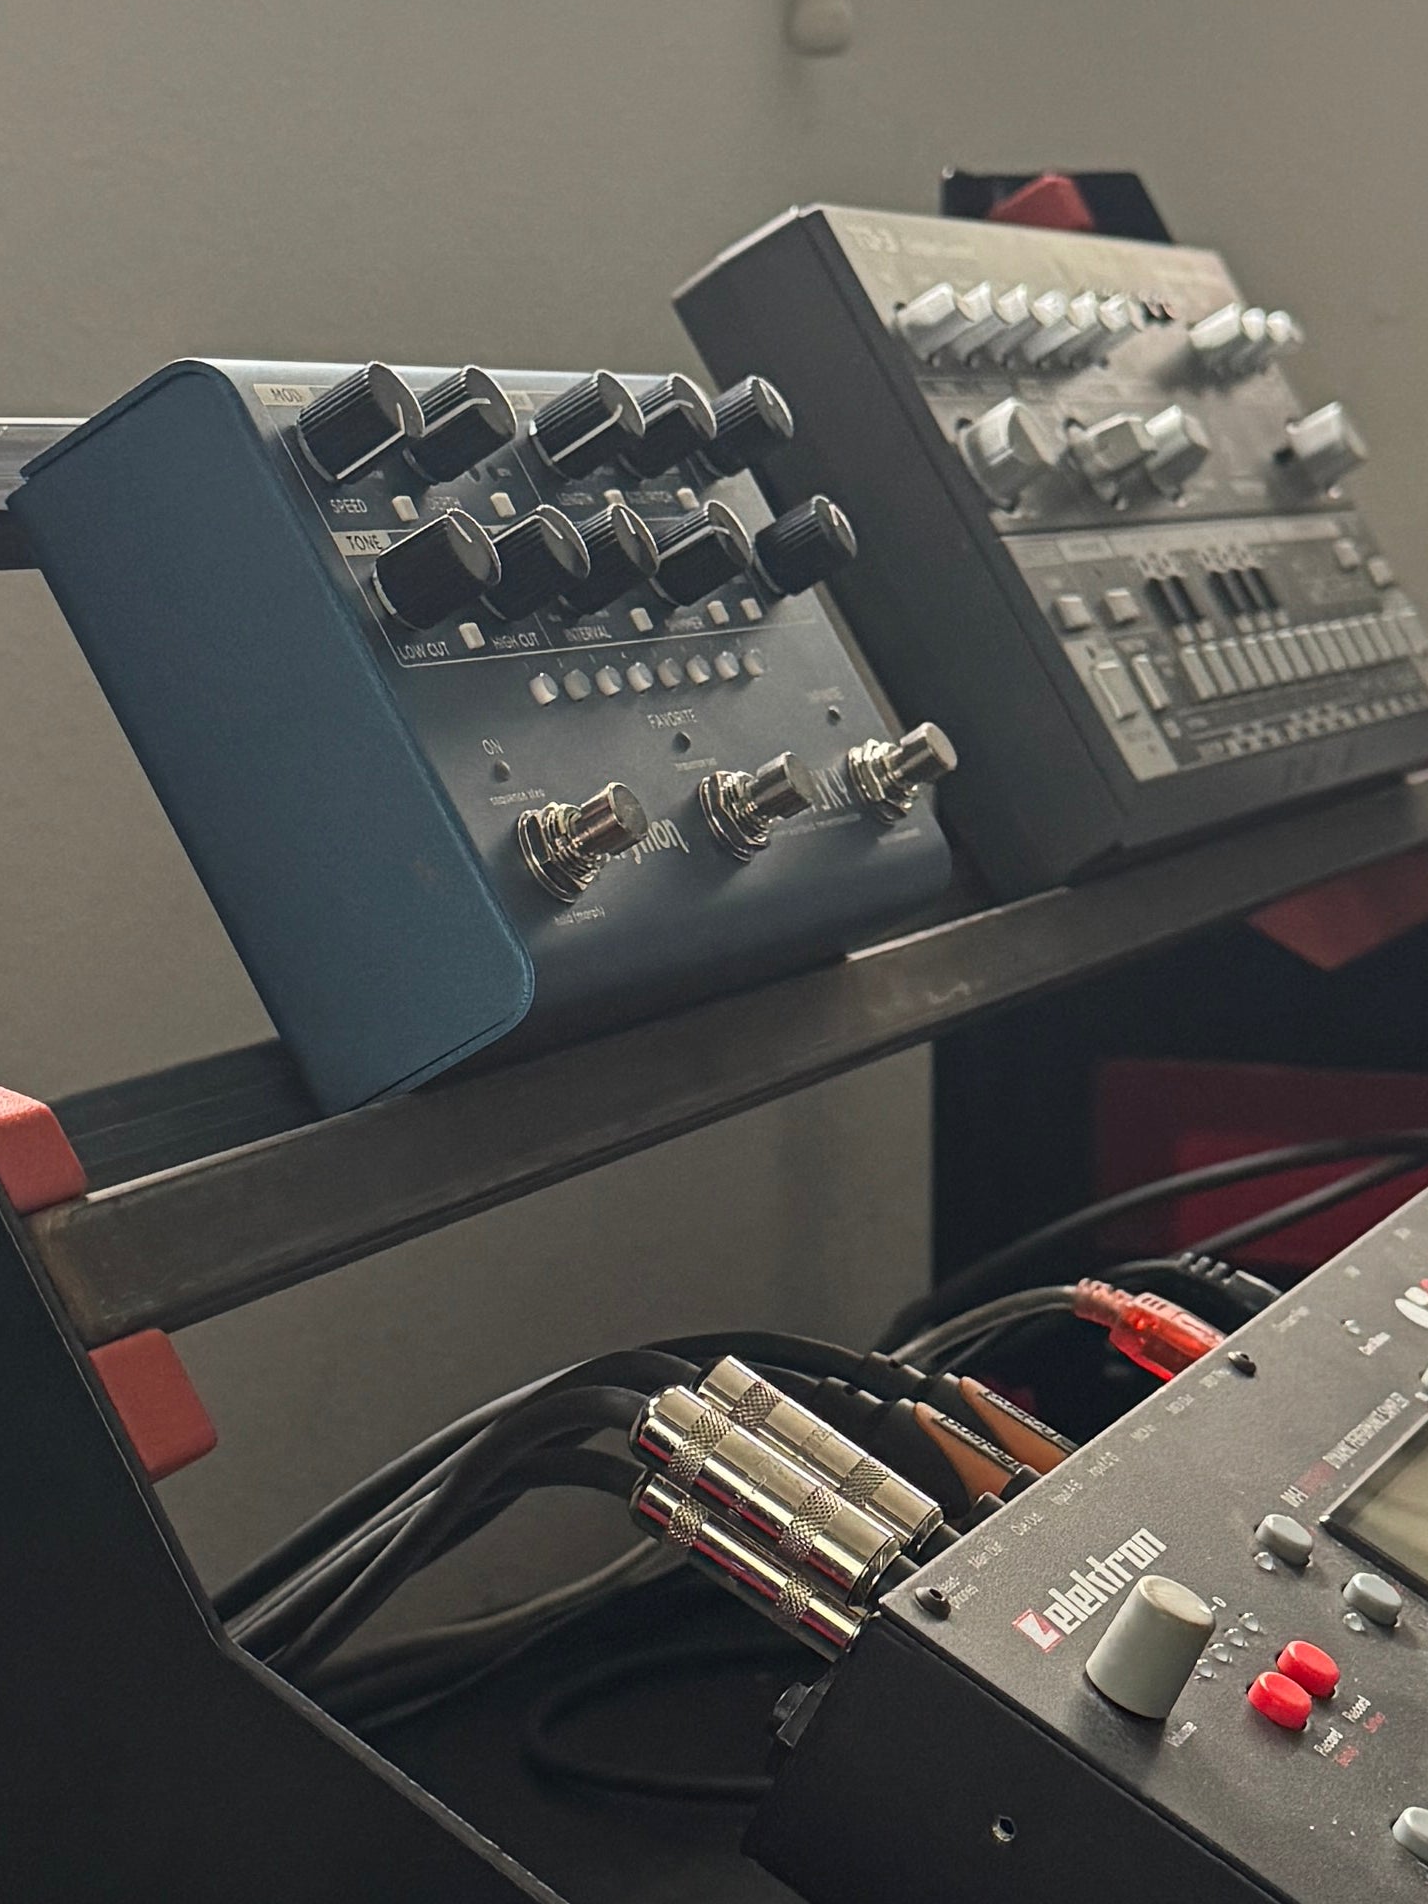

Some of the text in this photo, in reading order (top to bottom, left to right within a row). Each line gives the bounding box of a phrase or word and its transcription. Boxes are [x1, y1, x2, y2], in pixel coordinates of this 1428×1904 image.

[327, 498, 369, 513] SPEED
[345, 535, 384, 551] TONE
[516, 632, 541, 647] CUT
[396, 640, 451, 660] LOW CUT
[645, 708, 698, 730] FAVORITE
[480, 738, 504, 755] ON
[1042, 1527, 1169, 1638] elektron
[1341, 1694, 1372, 1723] Record
[1313, 1726, 1344, 1757] Record
